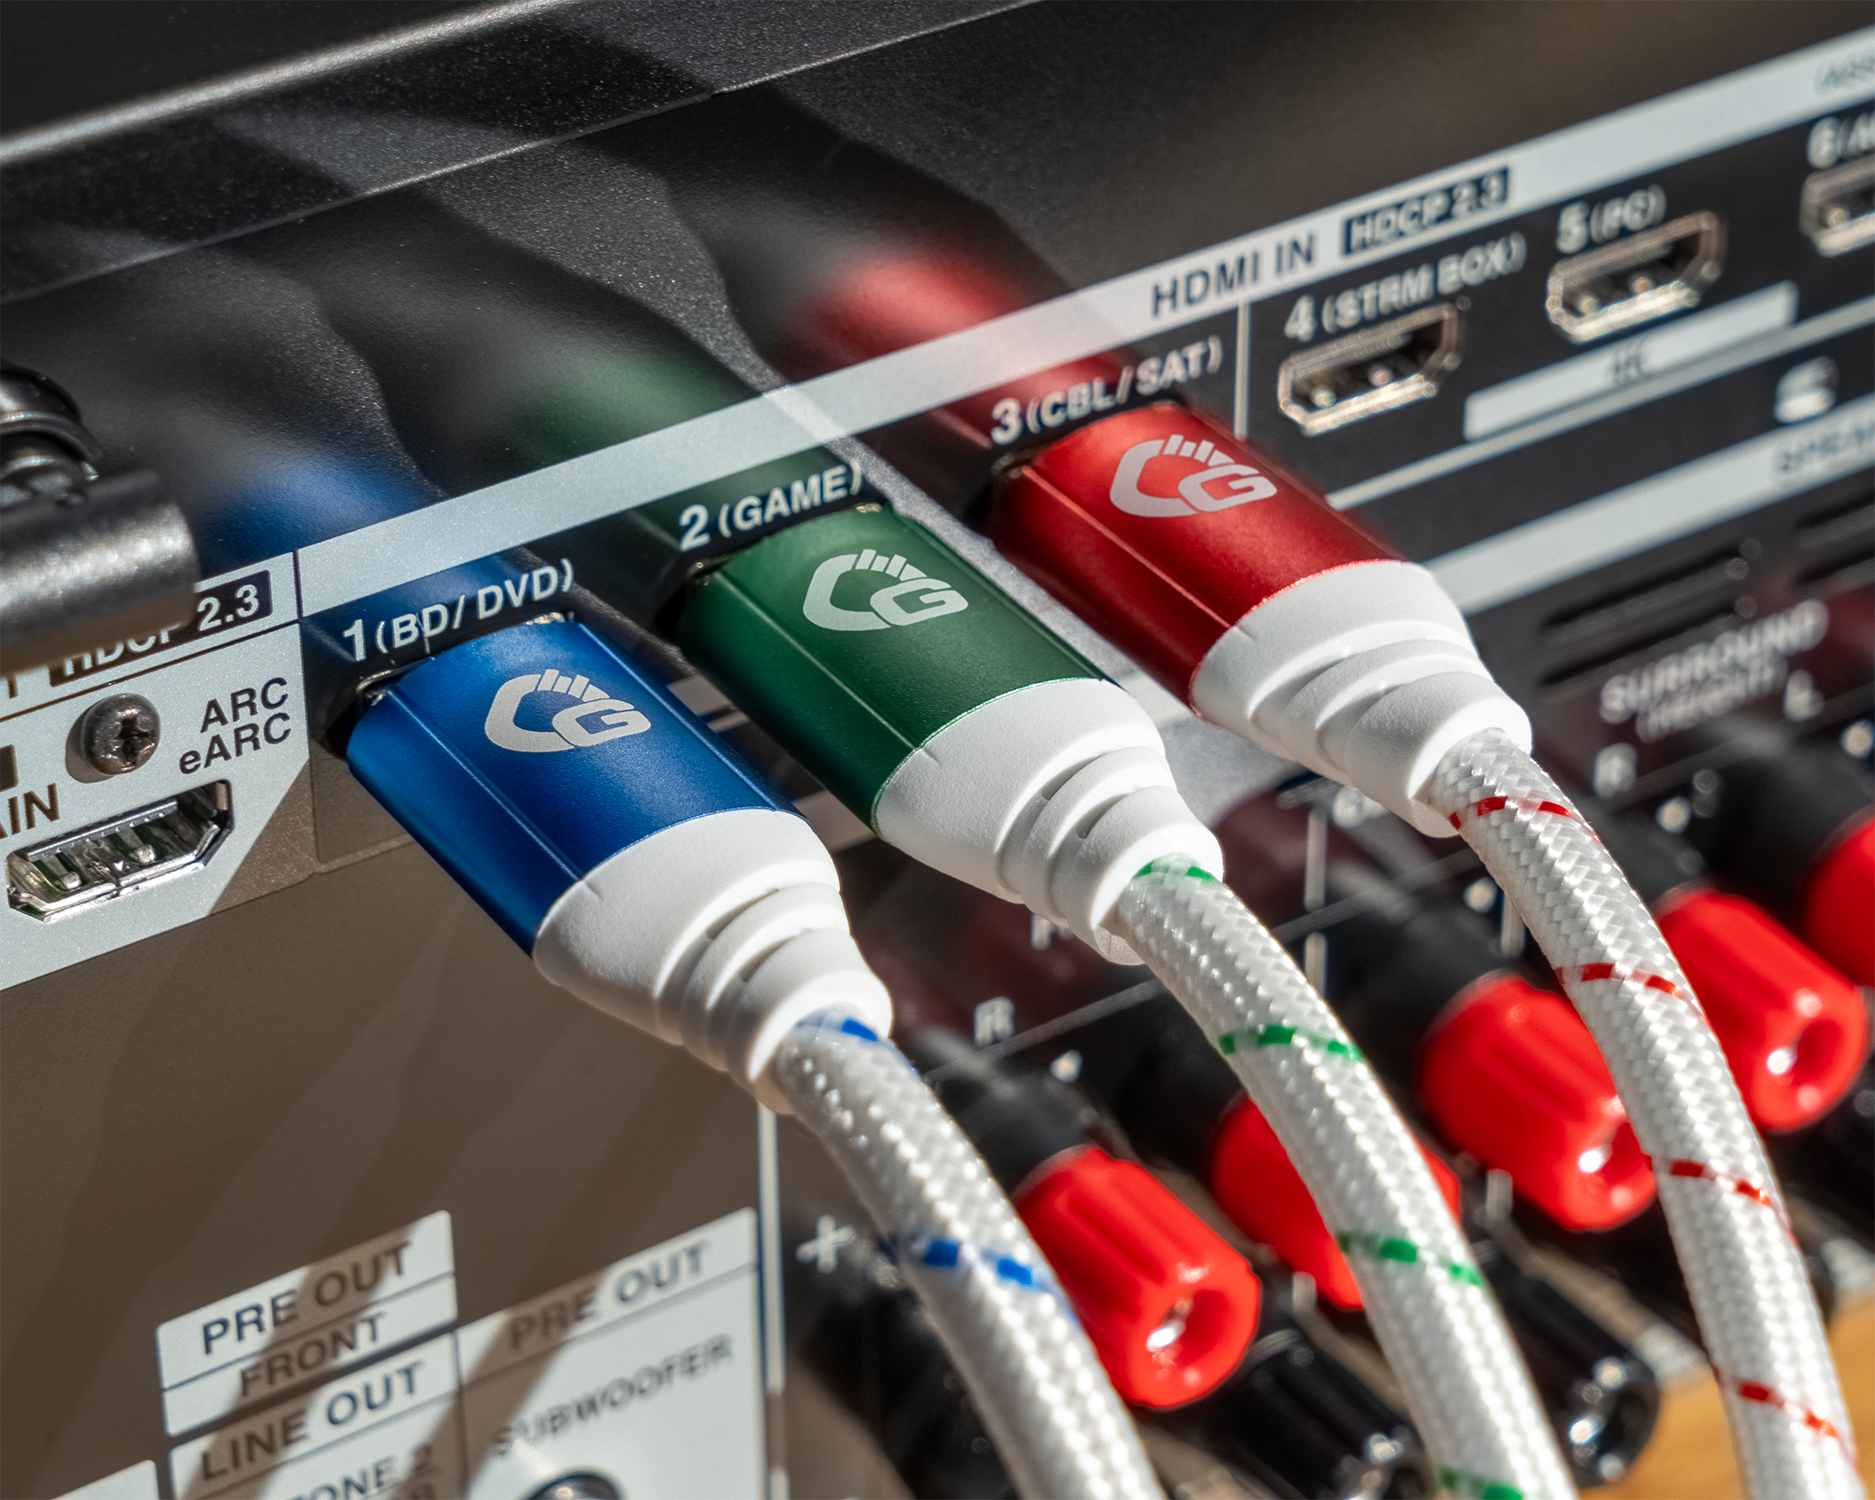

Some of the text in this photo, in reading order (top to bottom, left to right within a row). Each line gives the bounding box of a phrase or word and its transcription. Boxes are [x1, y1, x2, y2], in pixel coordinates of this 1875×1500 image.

[1153, 247, 1260, 320] HDMI
[1277, 233, 1316, 276] IN
[1349, 190, 1450, 252] HDCP
[1556, 201, 1590, 253] 5
[1285, 295, 1316, 342] 4
[1323, 264, 1435, 334] (STRM
[991, 397, 1023, 444] 3
[679, 459, 864, 552] 2 (GAME)
[197, 583, 260, 632] 2.3
[342, 618, 367, 662] 1
[179, 712, 291, 774] eARC
[200, 676, 289, 733] ARC
[202, 1240, 412, 1357] PRE OUT
[508, 1239, 711, 1351] PRE OUT
[240, 1311, 388, 1400] FRONT
[492, 1333, 734, 1457] SUBWOOFER
[202, 1360, 425, 1482] LINE OUT
